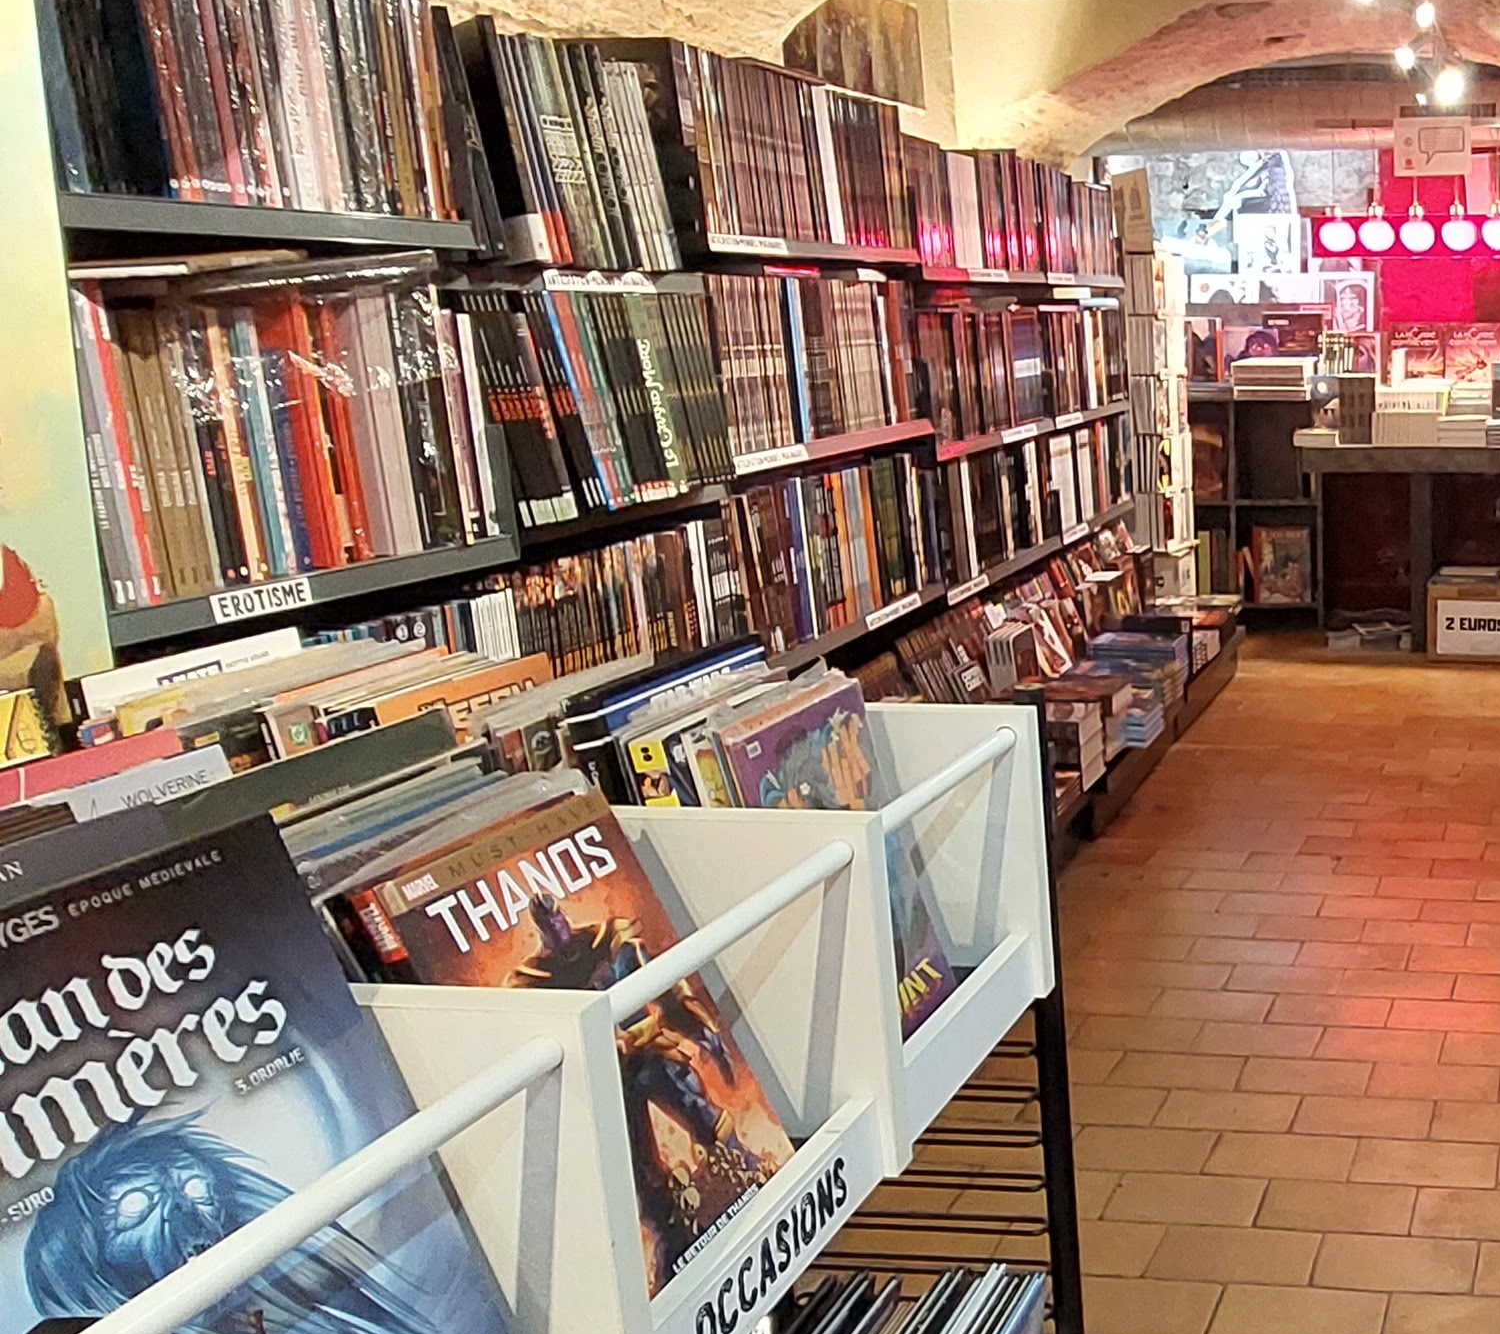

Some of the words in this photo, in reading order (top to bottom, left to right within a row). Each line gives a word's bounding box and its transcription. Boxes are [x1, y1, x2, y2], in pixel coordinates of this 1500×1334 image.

[218, 583, 307, 618] EROTISME
[1445, 618, 1455, 630] 2
[425, 825, 618, 954] THANOS
[0, 976, 111, 1077] an
[101, 927, 215, 1011] des
[685, 1226, 718, 1262] RETOUR
[717, 1216, 730, 1232] DE
